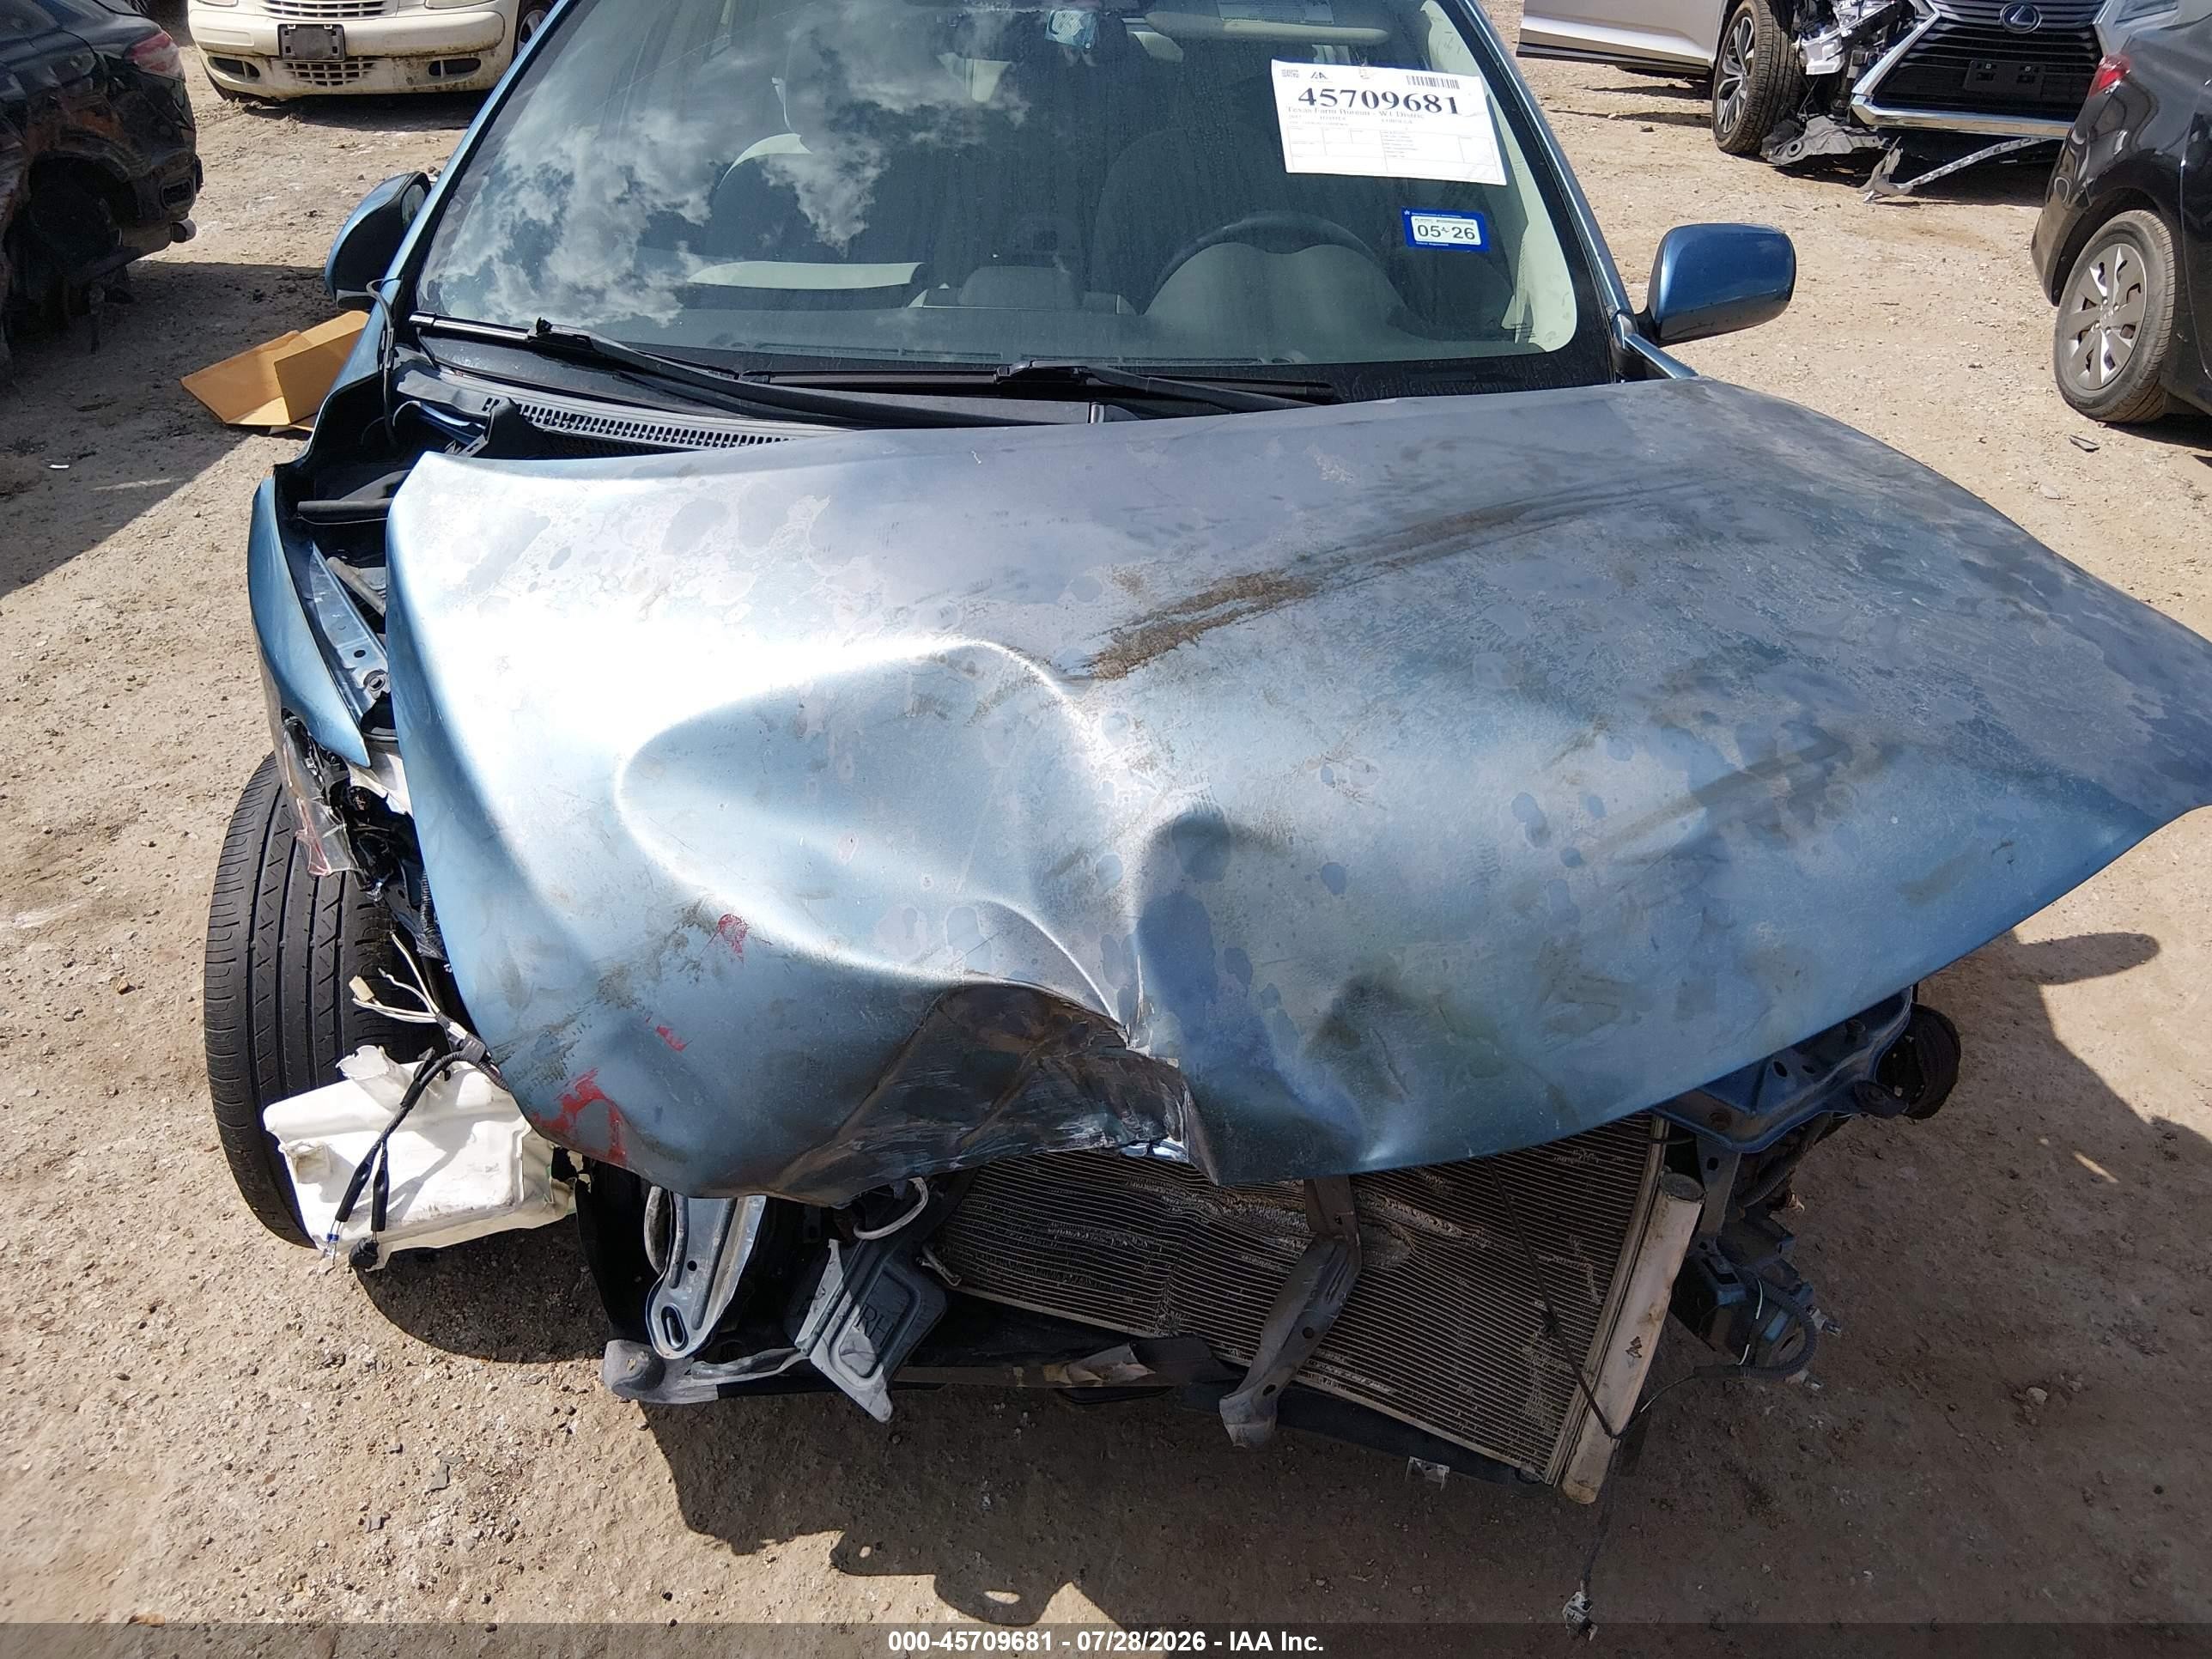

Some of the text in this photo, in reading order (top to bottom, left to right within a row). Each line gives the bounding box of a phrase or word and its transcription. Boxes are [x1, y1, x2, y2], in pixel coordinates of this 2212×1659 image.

[1297, 87, 1462, 115] 45709681
[1417, 224, 1476, 240] 05 26
